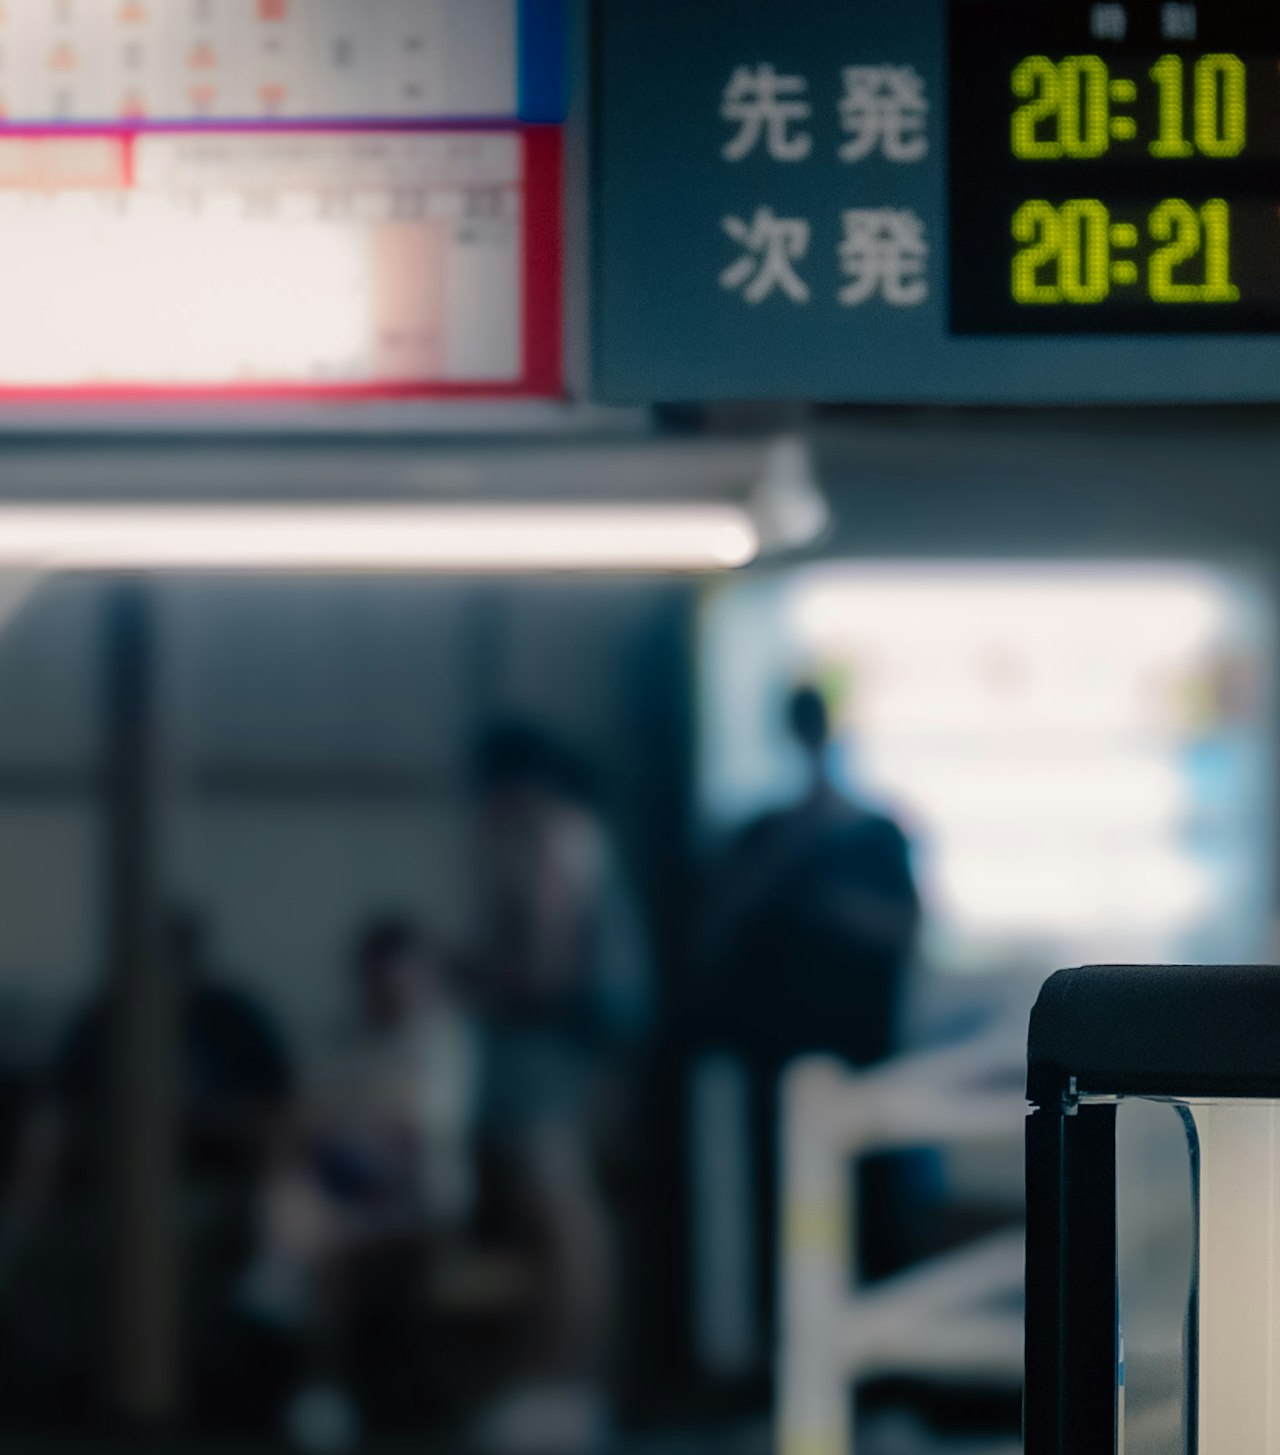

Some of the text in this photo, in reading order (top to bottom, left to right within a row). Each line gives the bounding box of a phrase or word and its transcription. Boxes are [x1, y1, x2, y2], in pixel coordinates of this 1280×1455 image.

[720, 63, 926, 162] 先発
[1011, 53, 1246, 159] 20:10
[720, 206, 928, 306] 次発
[1011, 198, 1239, 303] 20:21
